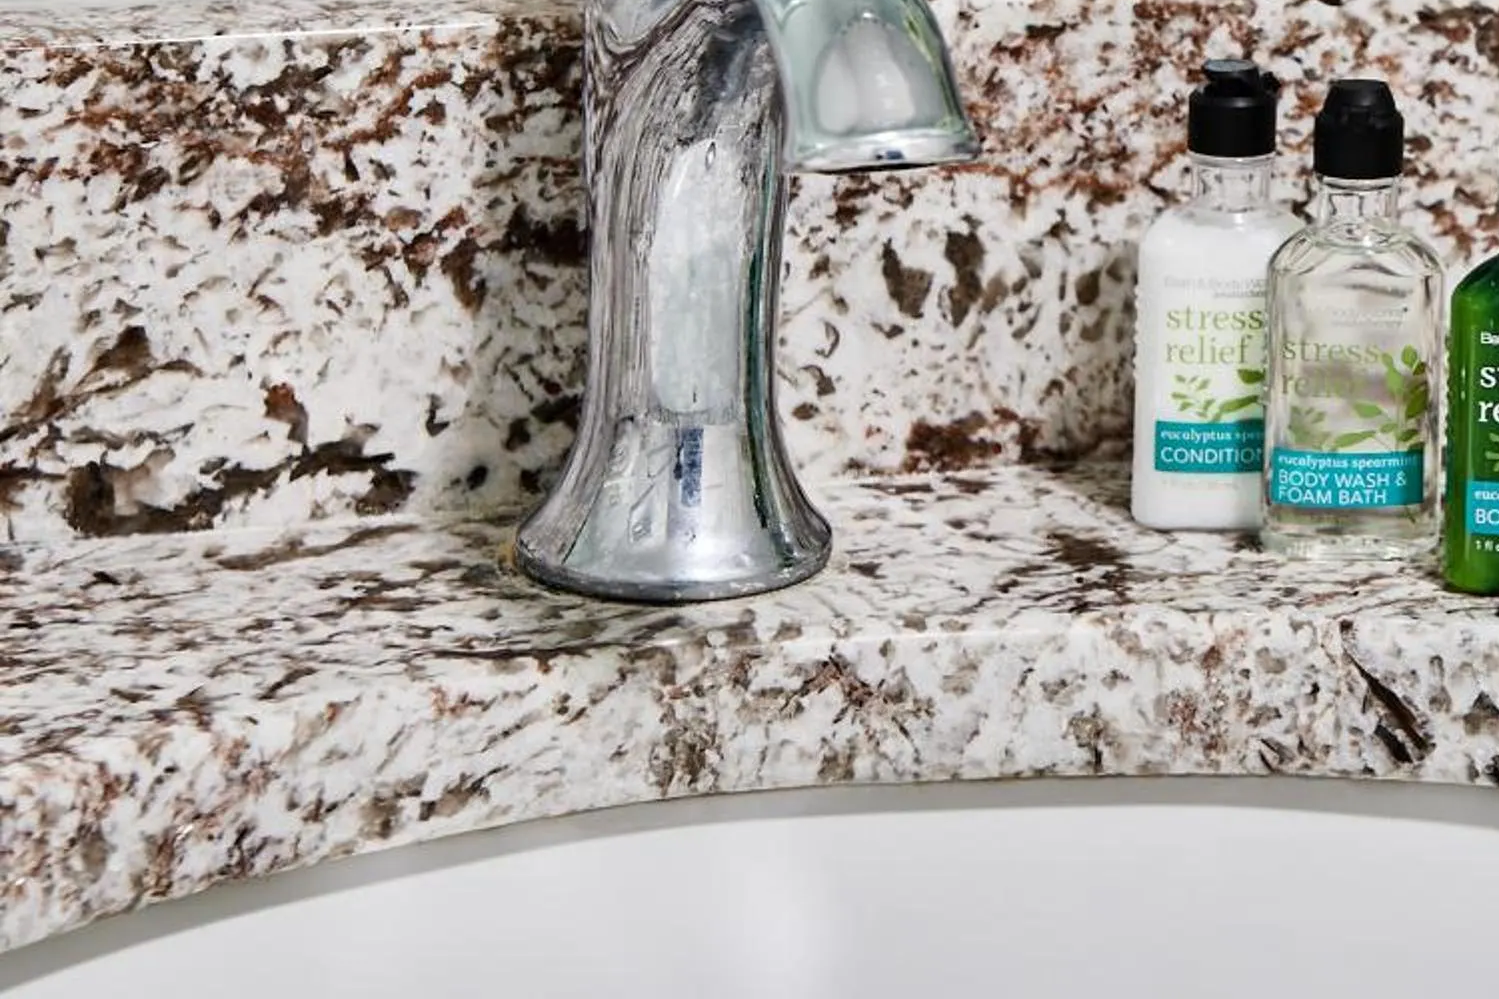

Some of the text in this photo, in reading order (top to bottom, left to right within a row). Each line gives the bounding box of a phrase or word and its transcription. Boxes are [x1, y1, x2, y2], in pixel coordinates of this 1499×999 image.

[1166, 304, 1264, 330] stress
[1166, 335, 1253, 364] relief
[1282, 338, 1378, 364] stress
[1277, 455, 1349, 470] eucalyptus
[1278, 469, 1407, 488] BODY WASH &
[1278, 487, 1387, 505] FOAM BATH
[1475, 540, 1482, 550] 1
